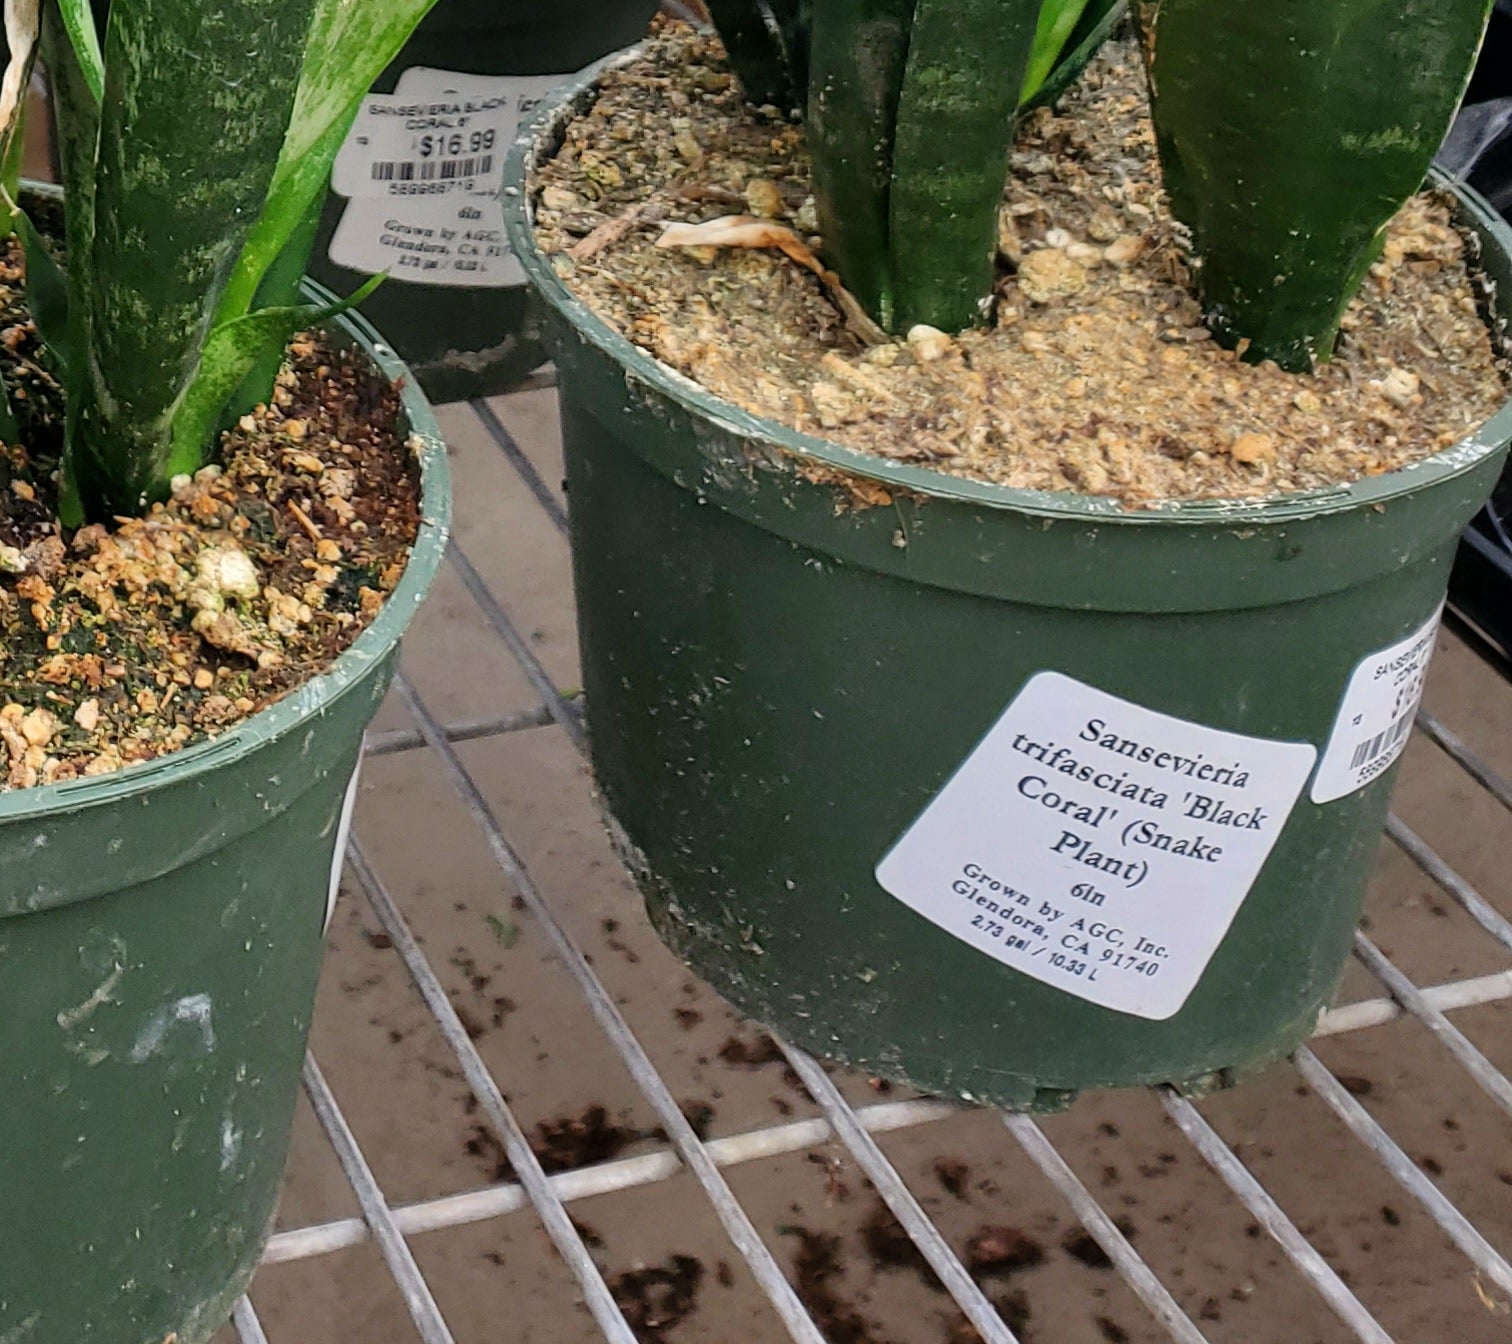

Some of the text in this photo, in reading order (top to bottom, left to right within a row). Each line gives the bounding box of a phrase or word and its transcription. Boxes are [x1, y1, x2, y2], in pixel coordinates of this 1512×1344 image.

[419, 128, 496, 157] $16.99
[1011, 733, 1269, 830] trifasciata 'Black
[1078, 718, 1250, 788] Sansevieria
[1017, 775, 1223, 863] Coral' (Snake
[1050, 830, 1149, 888] Plant)
[952, 879, 1160, 977] Glendora, CA 91740
[963, 863, 1170, 959] Grown by AGC, Inc.
[970, 914, 1004, 938] 2.73
[1048, 952, 1087, 976] 10.33
